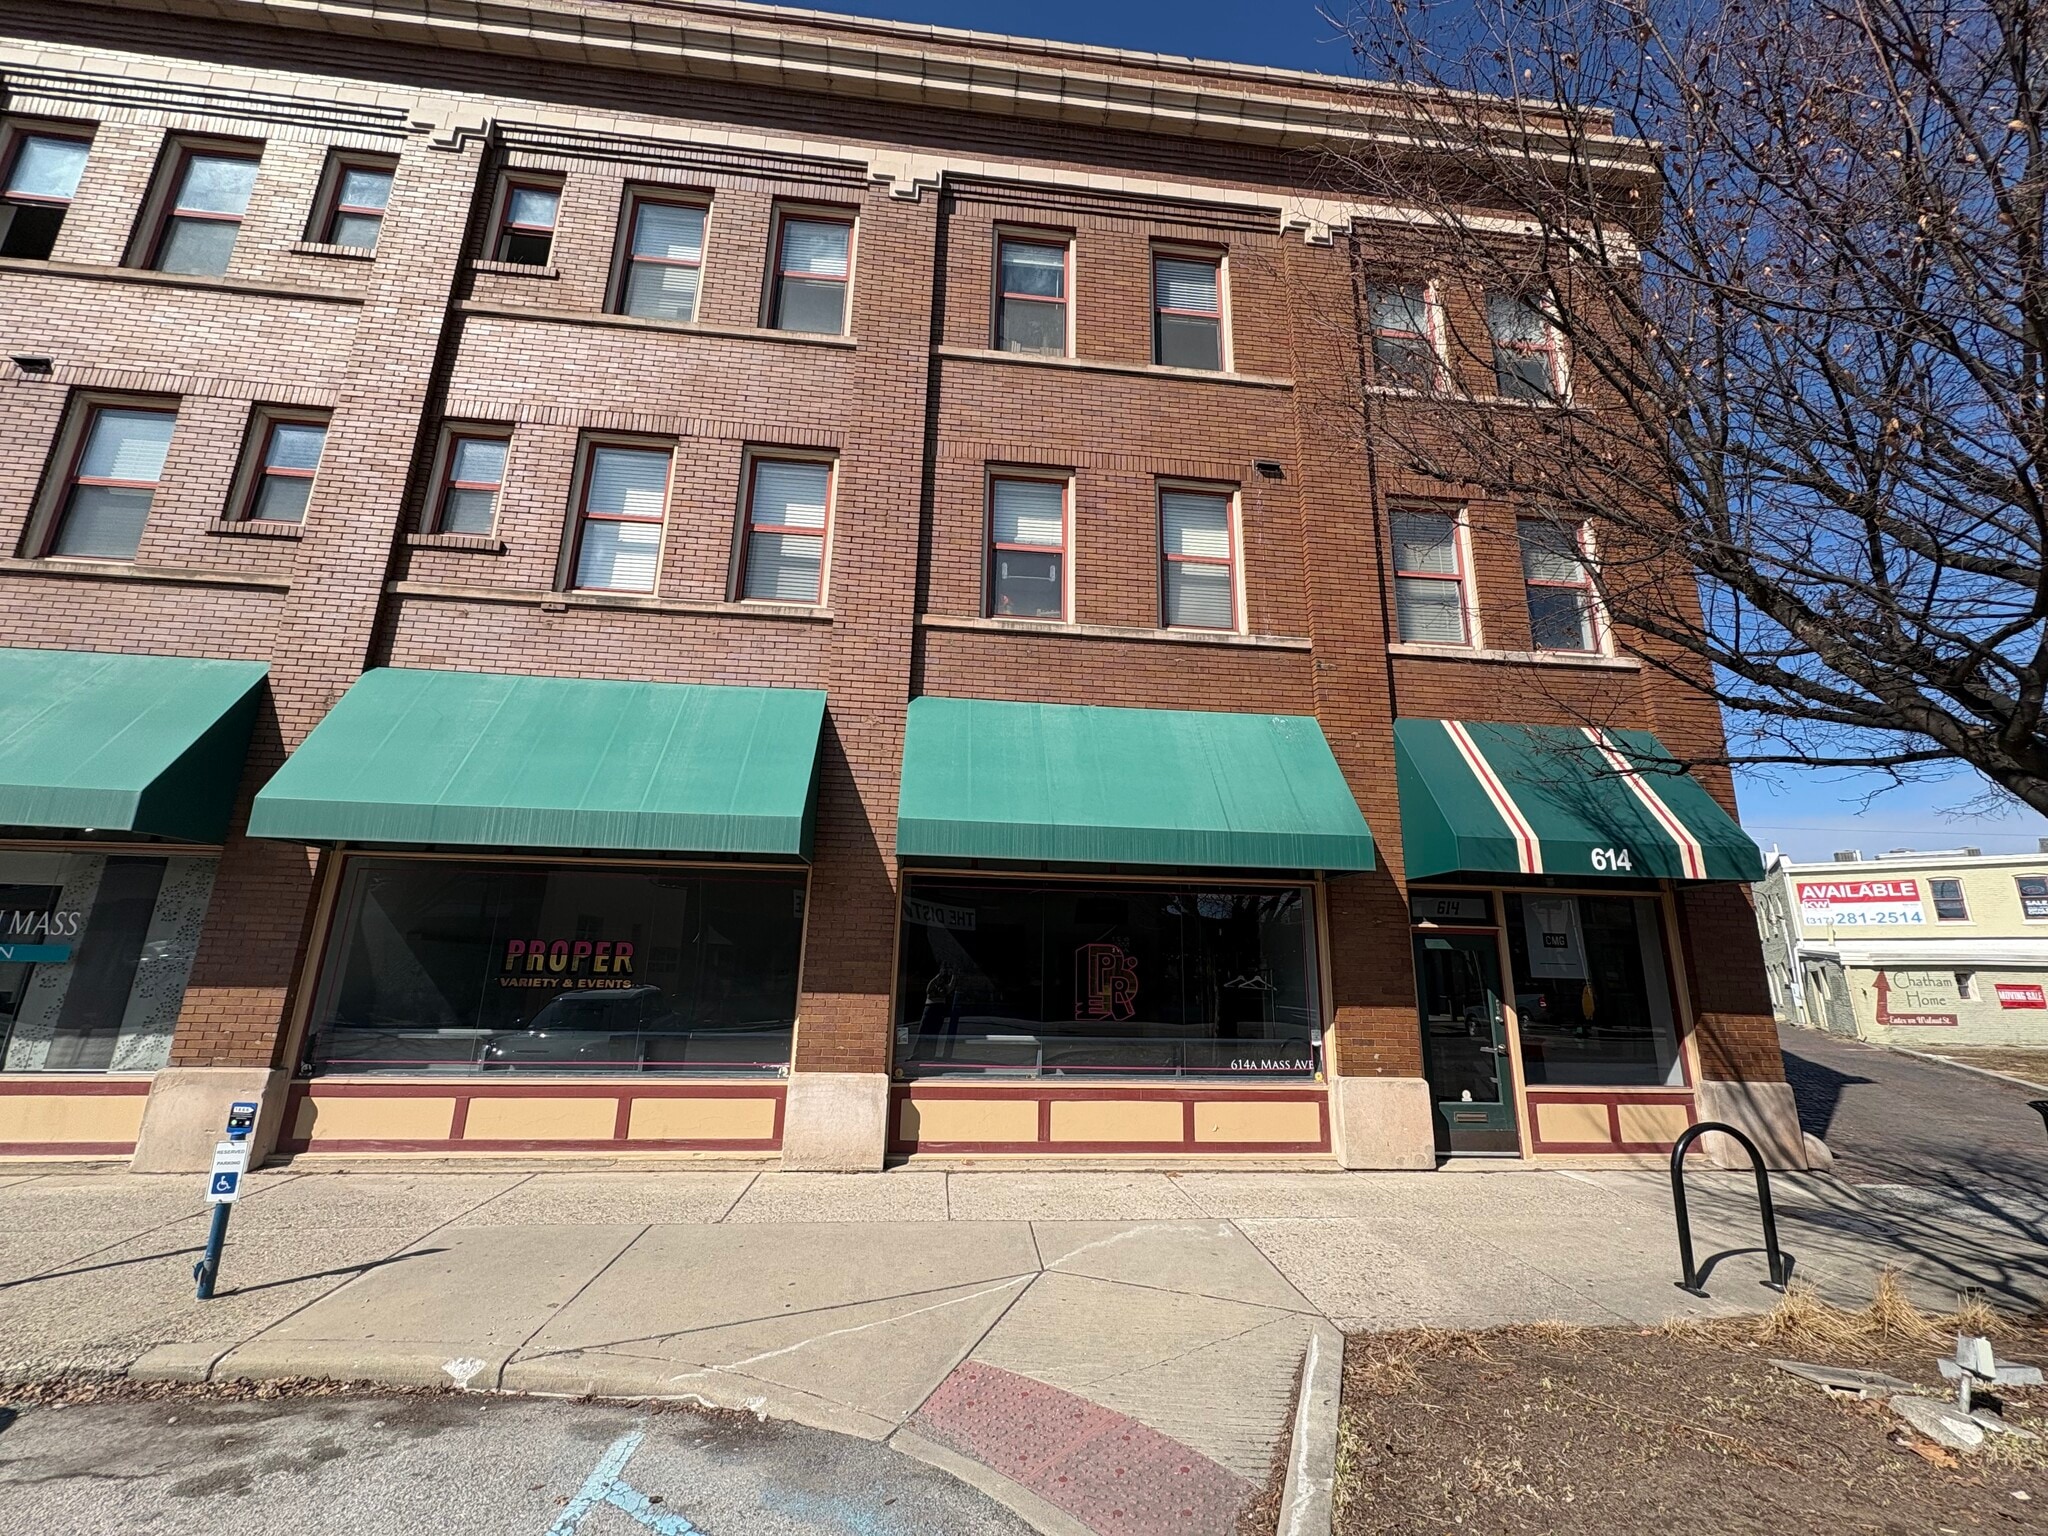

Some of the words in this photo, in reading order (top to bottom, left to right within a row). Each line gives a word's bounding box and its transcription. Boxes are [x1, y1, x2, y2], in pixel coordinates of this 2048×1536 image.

[1591, 848, 1632, 871] 614
[1802, 882, 1916, 898] AVAILABLE
[1437, 901, 1459, 915] 614
[8, 910, 81, 936] MASS
[1835, 911, 1923, 924] 281-2514
[1545, 935, 1565, 946] CMG
[505, 939, 634, 973] PROPER
[500, 977, 559, 988] VARIETY
[562, 979, 573, 987] &
[577, 979, 632, 989] EVENTS
[1893, 971, 1953, 989] Chatham
[1906, 991, 1946, 1007] Home
[1998, 991, 2025, 1000] MOVING
[2025, 991, 2043, 1000] SALE
[1889, 1016, 1907, 1024] Enter
[1916, 1016, 1942, 1024] Walnut
